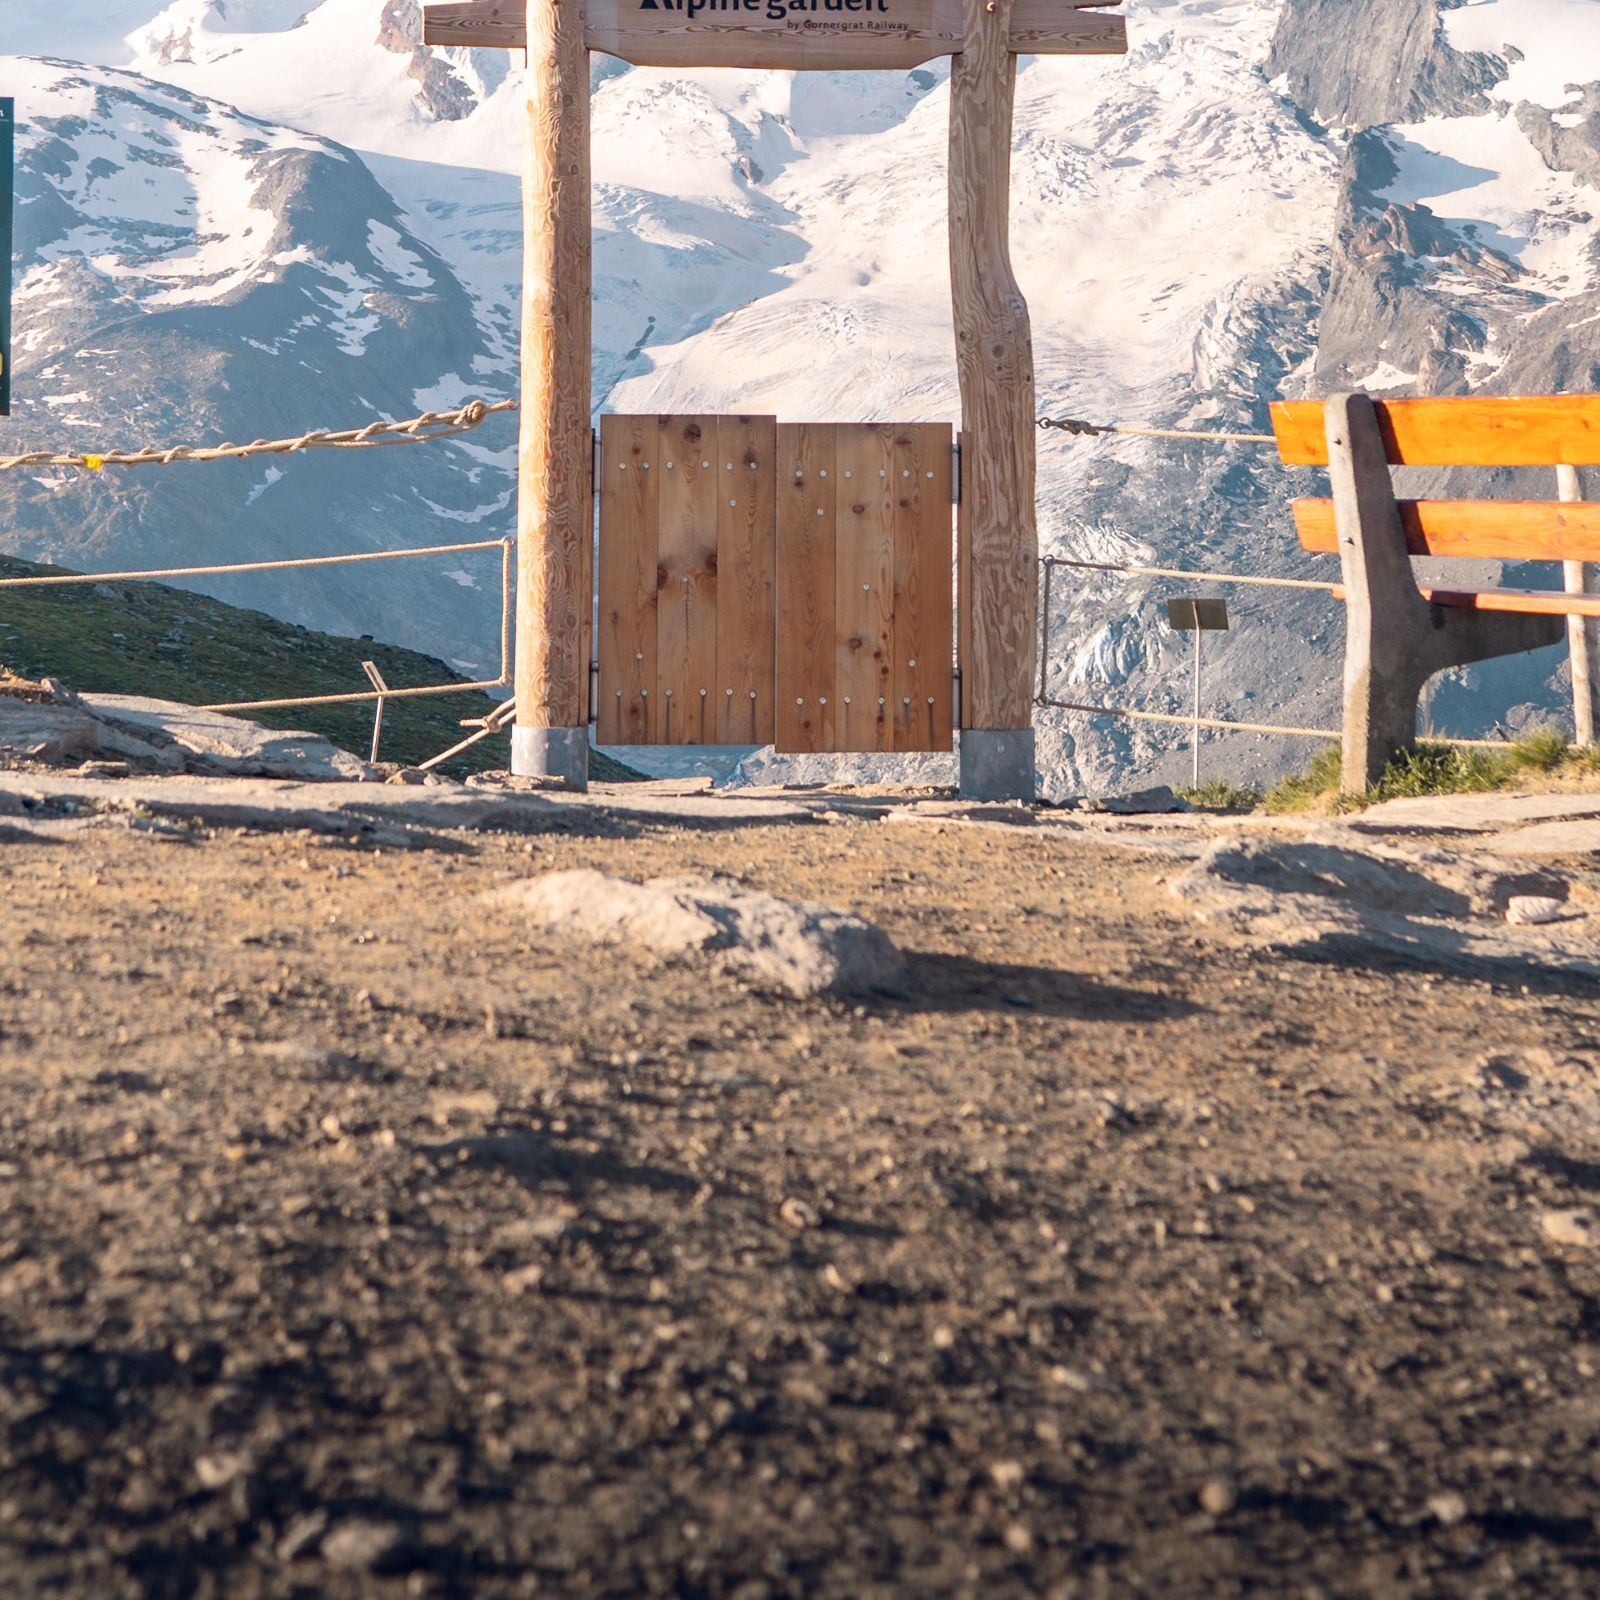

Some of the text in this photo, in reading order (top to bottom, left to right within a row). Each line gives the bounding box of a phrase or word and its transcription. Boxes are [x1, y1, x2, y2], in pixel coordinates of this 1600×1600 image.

[787, 20, 908, 31] by Gornergrat Railway
